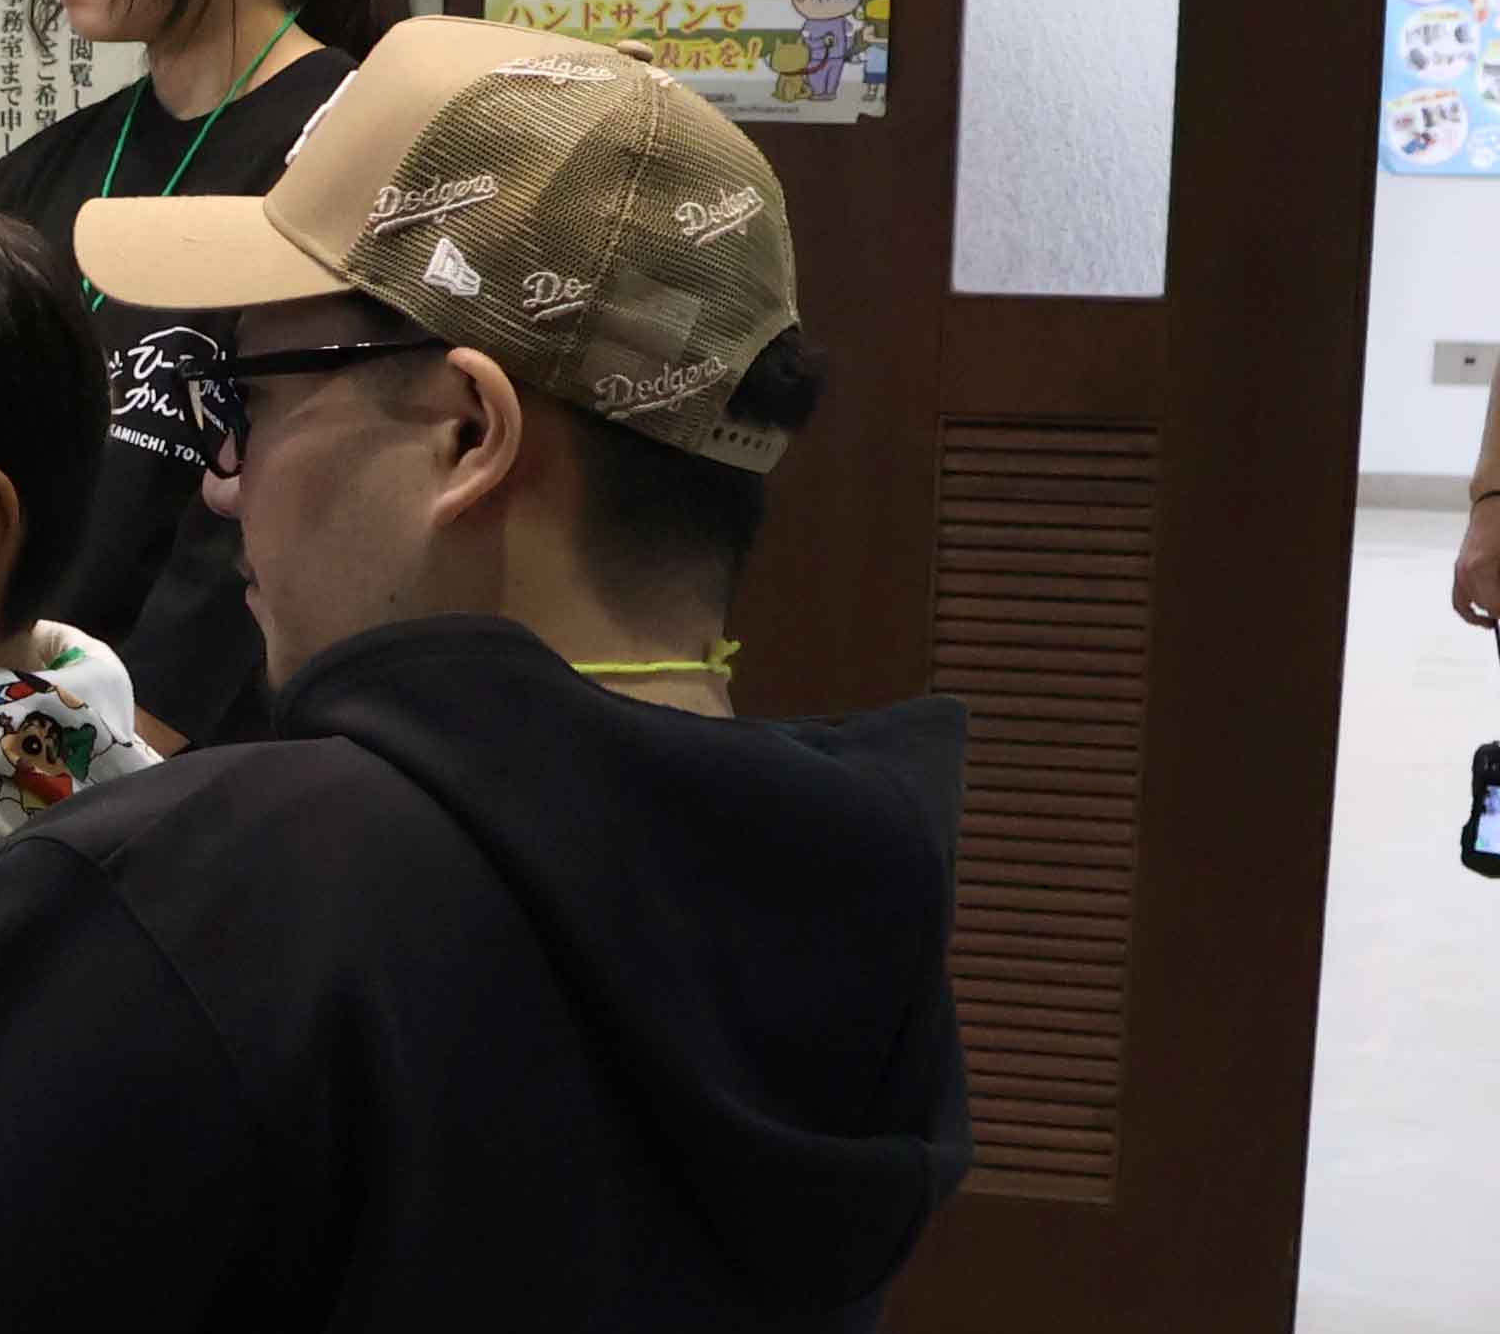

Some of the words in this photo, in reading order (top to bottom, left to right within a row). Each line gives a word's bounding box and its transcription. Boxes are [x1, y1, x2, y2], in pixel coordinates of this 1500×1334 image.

[507, 0, 746, 36] ハンドサインで
[367, 174, 499, 235] Dodgers
[595, 355, 729, 418] Dodgers
